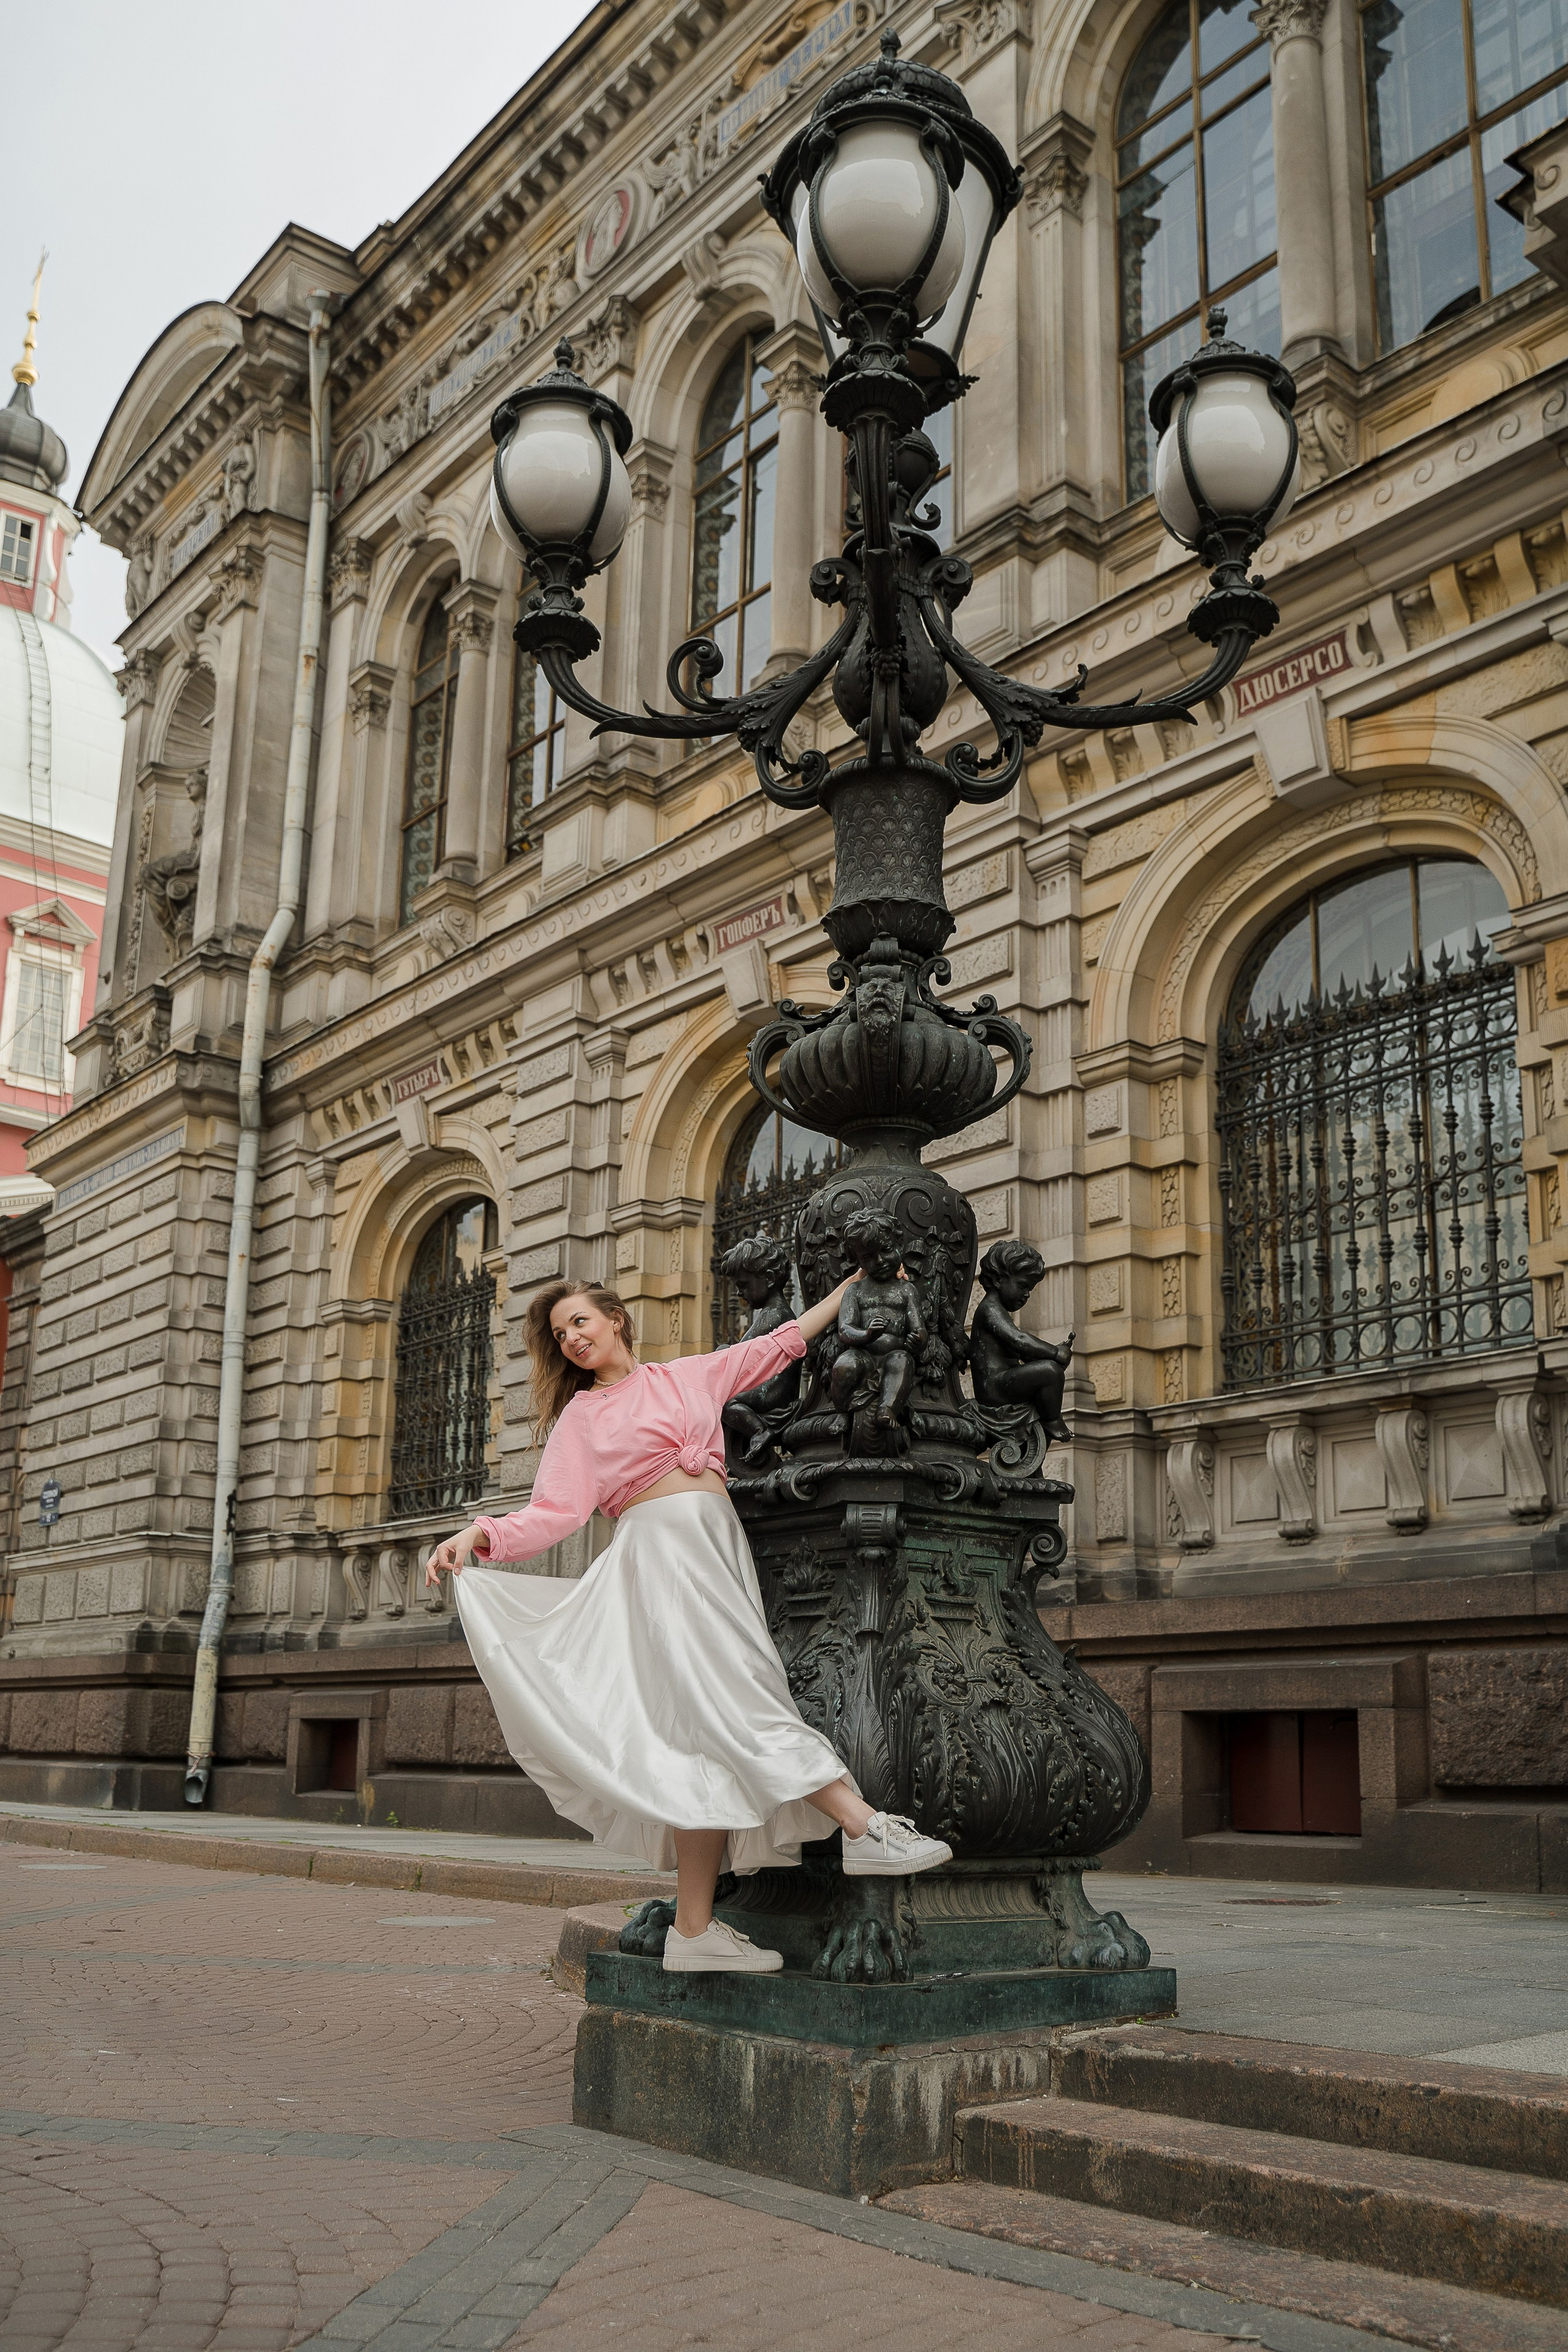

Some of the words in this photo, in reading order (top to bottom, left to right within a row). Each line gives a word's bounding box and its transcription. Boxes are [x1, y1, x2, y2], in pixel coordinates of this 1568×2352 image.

[1238, 640, 1344, 713] ДЮСЕРСО
[718, 903, 782, 949] ГОПФЕРЪ
[397, 1066, 438, 1099] ГУТЬЕРЪ
